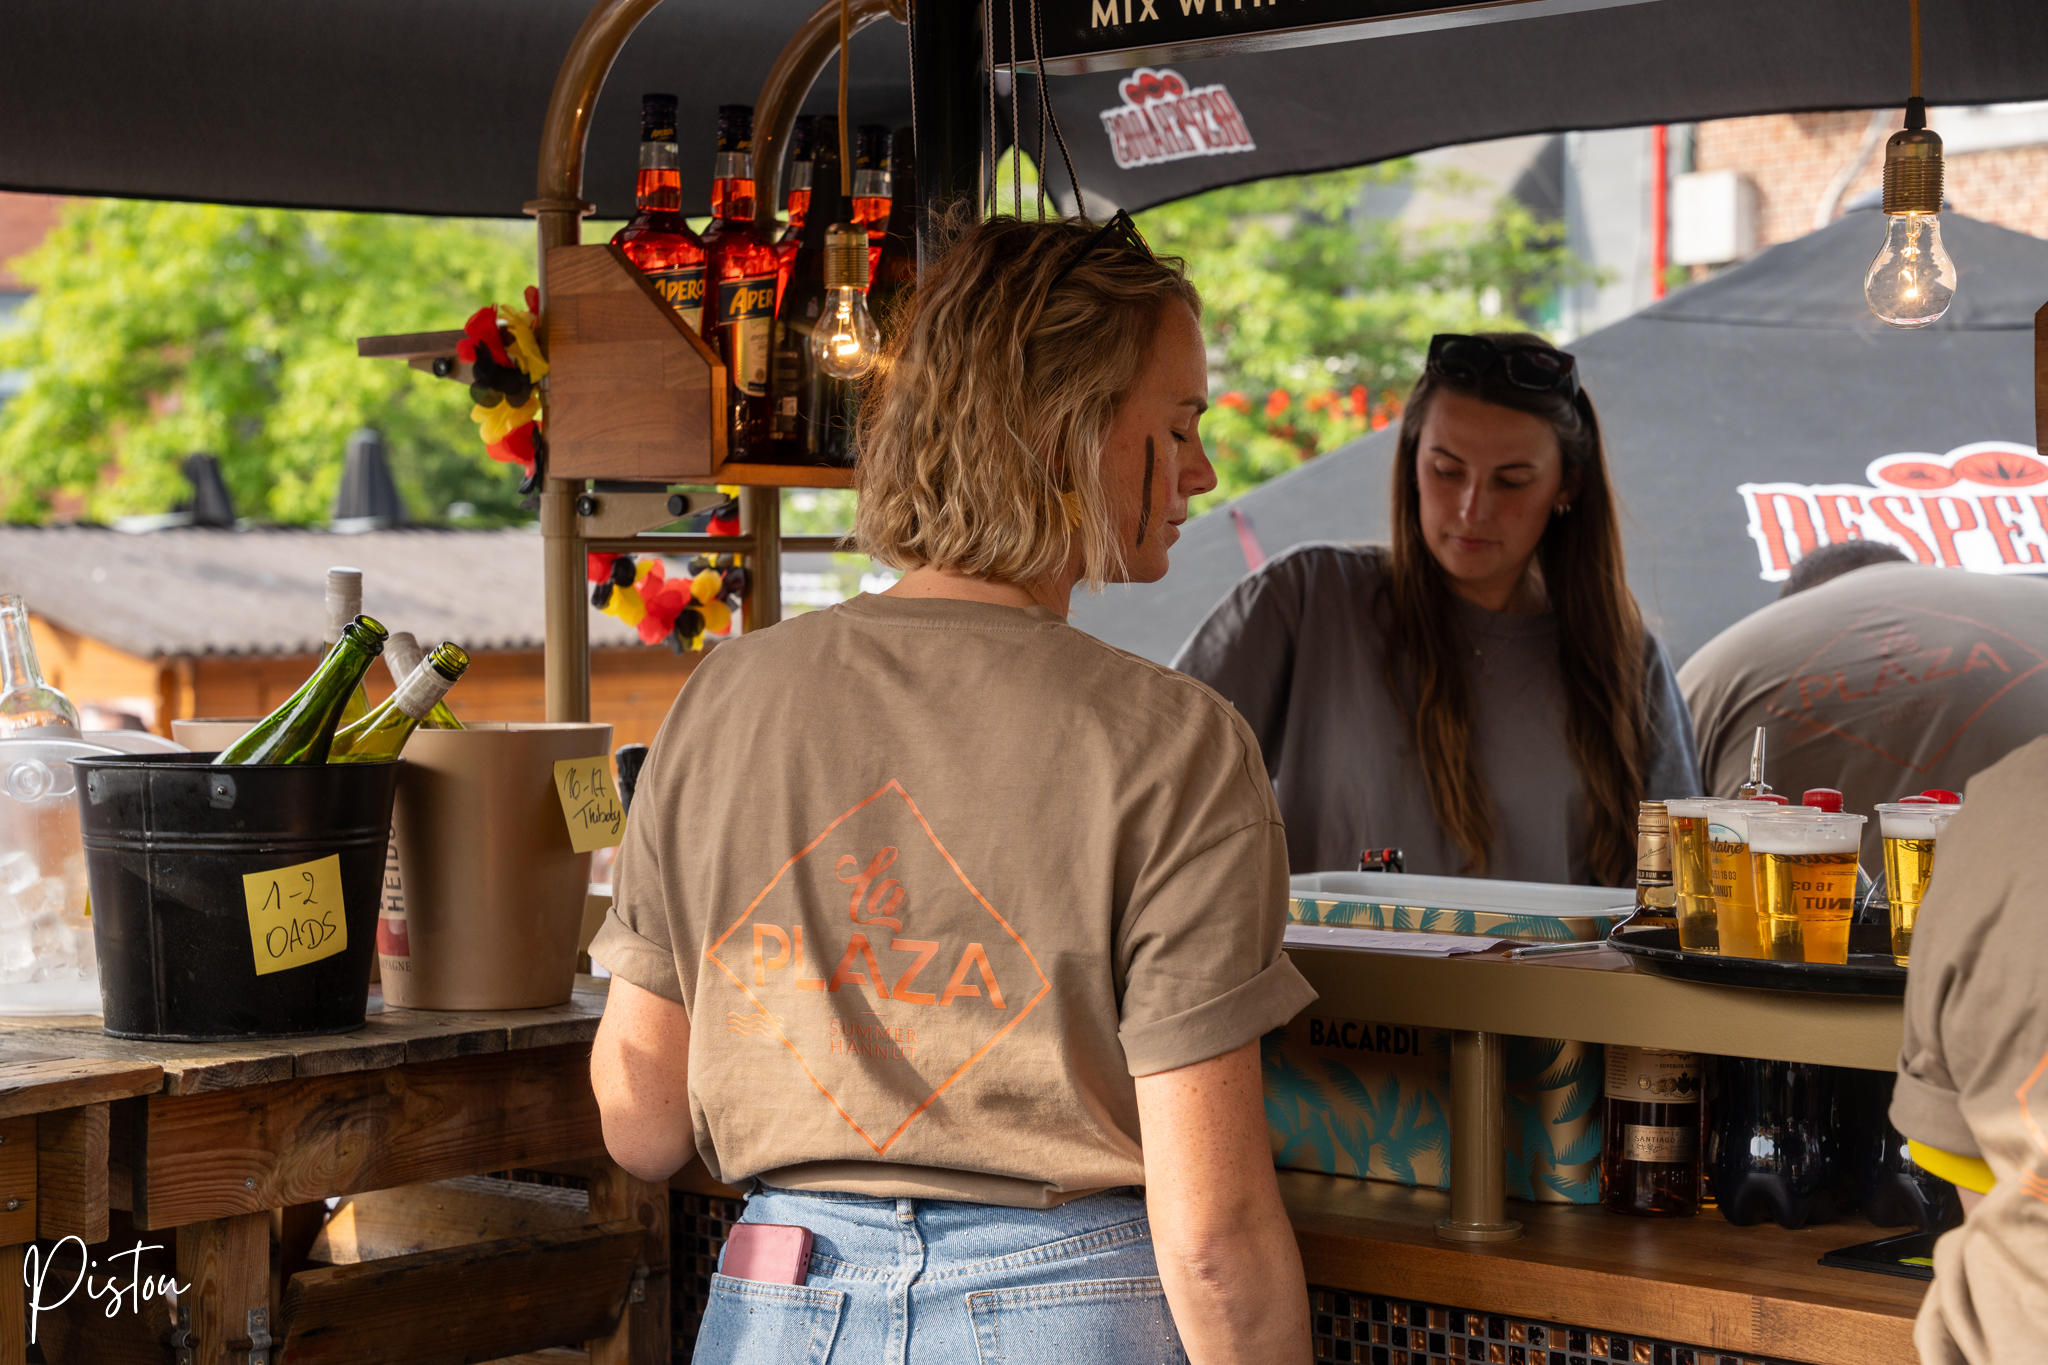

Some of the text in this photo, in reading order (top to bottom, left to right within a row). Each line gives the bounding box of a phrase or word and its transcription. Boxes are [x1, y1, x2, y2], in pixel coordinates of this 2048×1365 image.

[1091, 0, 1160, 28] MIX
[1797, 641, 2012, 712] PLAZA
[752, 922, 1007, 1010] PLAZA
[829, 1020, 918, 1044] SUMMER
[829, 1038, 917, 1061] HANNUT
[1634, 1135, 1676, 1144] SANTIAGO
